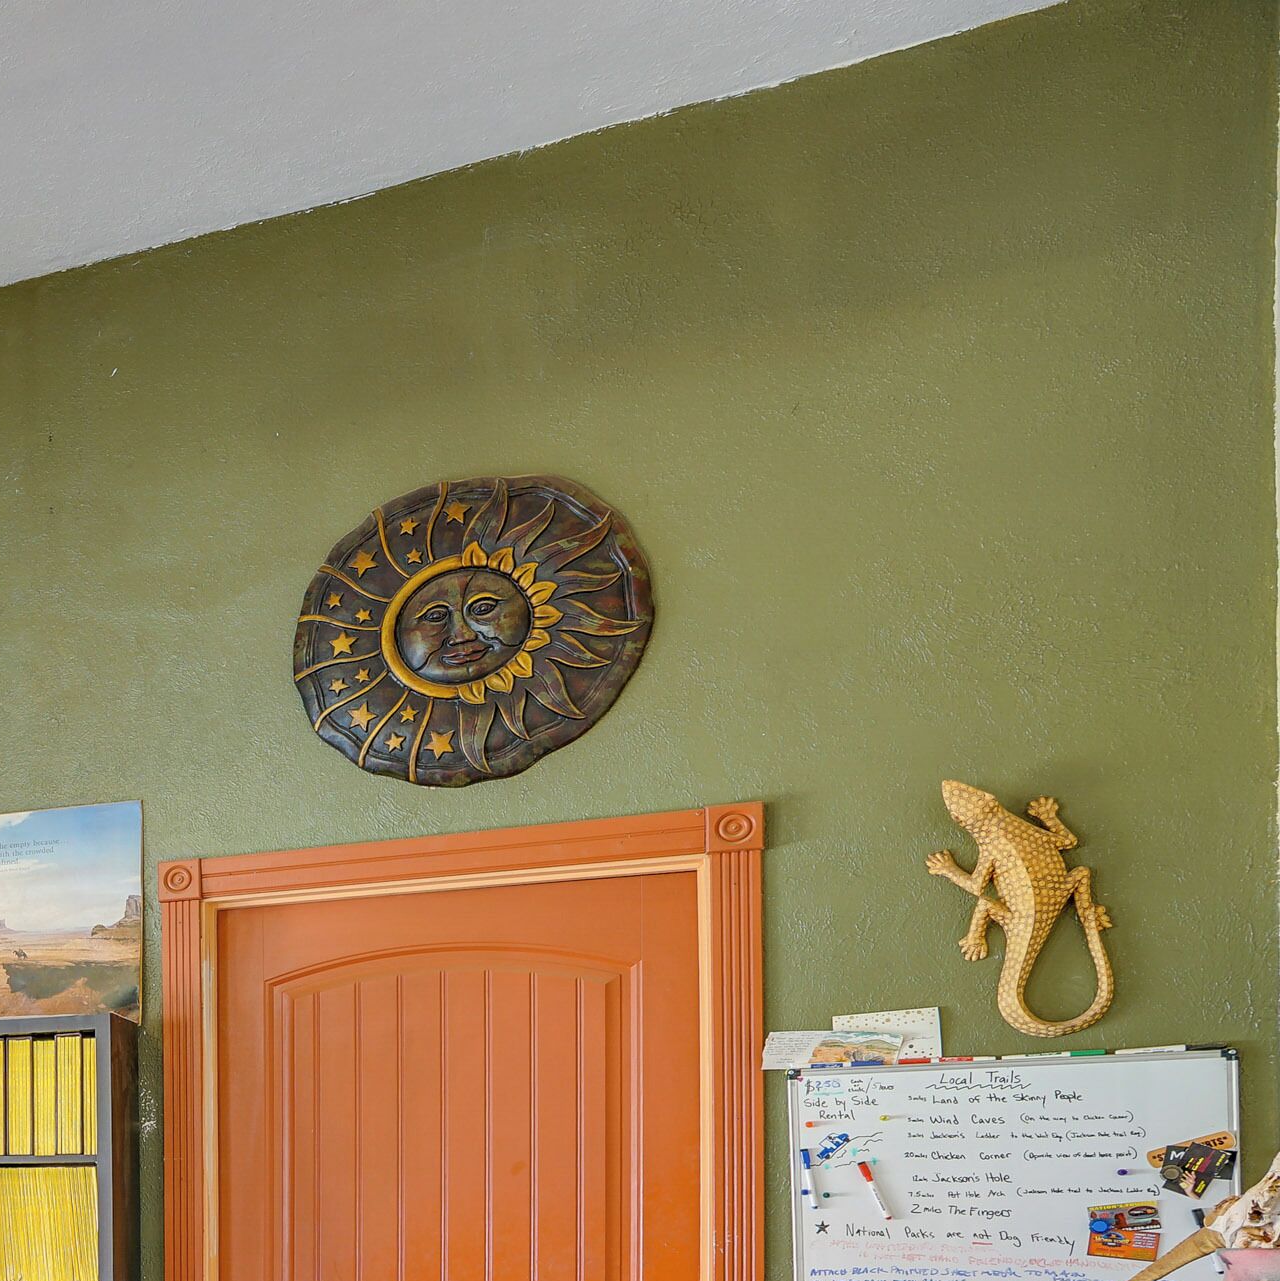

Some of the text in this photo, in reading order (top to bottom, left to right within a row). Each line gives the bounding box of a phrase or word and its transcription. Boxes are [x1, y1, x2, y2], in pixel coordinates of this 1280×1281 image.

[9, 841, 30, 850] empty
[13, 849, 24, 857] the
[26, 847, 54, 855] crowded
[939, 1070, 1022, 1085] Local Trails
[804, 1095, 879, 1111] Side by Side
[932, 1089, 1083, 1107] Land of the Skinny People
[819, 1109, 856, 1120] Rental
[930, 1114, 960, 1125] Wind
[971, 1113, 1006, 1124] Caves
[976, 1131, 1000, 1139] Ladder
[931, 1151, 966, 1161] Chicken
[979, 1151, 1012, 1161] Corner
[931, 1172, 1013, 1184] Jackson's Hole
[965, 1191, 981, 1199] Hole
[988, 1190, 1006, 1198] Arch
[910, 1204, 1012, 1219] 2 miles The Fingers
[846, 1223, 891, 1239] National
[904, 1226, 936, 1239] Parks
[946, 1230, 964, 1239] are
[972, 1229, 993, 1239] not
[999, 1231, 1022, 1247] Dog
[1031, 1232, 1075, 1256] Friendly
[852, 1267, 888, 1275] BLACK
